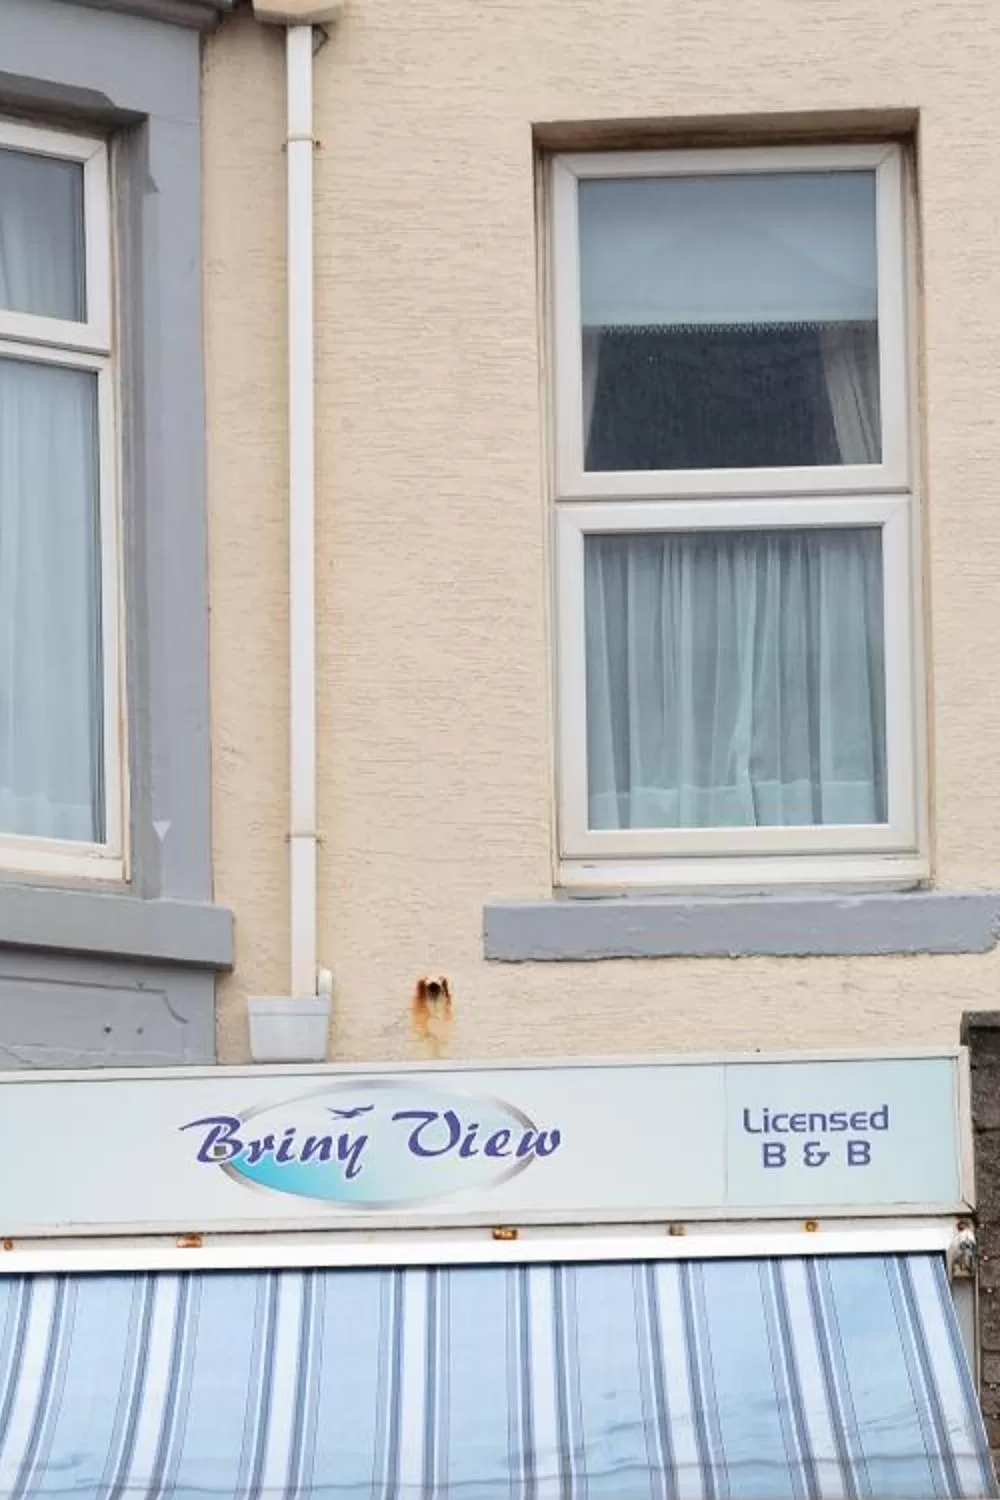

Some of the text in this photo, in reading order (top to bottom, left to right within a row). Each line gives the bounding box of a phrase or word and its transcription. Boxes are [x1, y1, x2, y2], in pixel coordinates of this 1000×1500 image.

[743, 1104, 889, 1134] Licensed
[178, 1109, 562, 1179] Briny View
[762, 1140, 871, 1169] B & B
